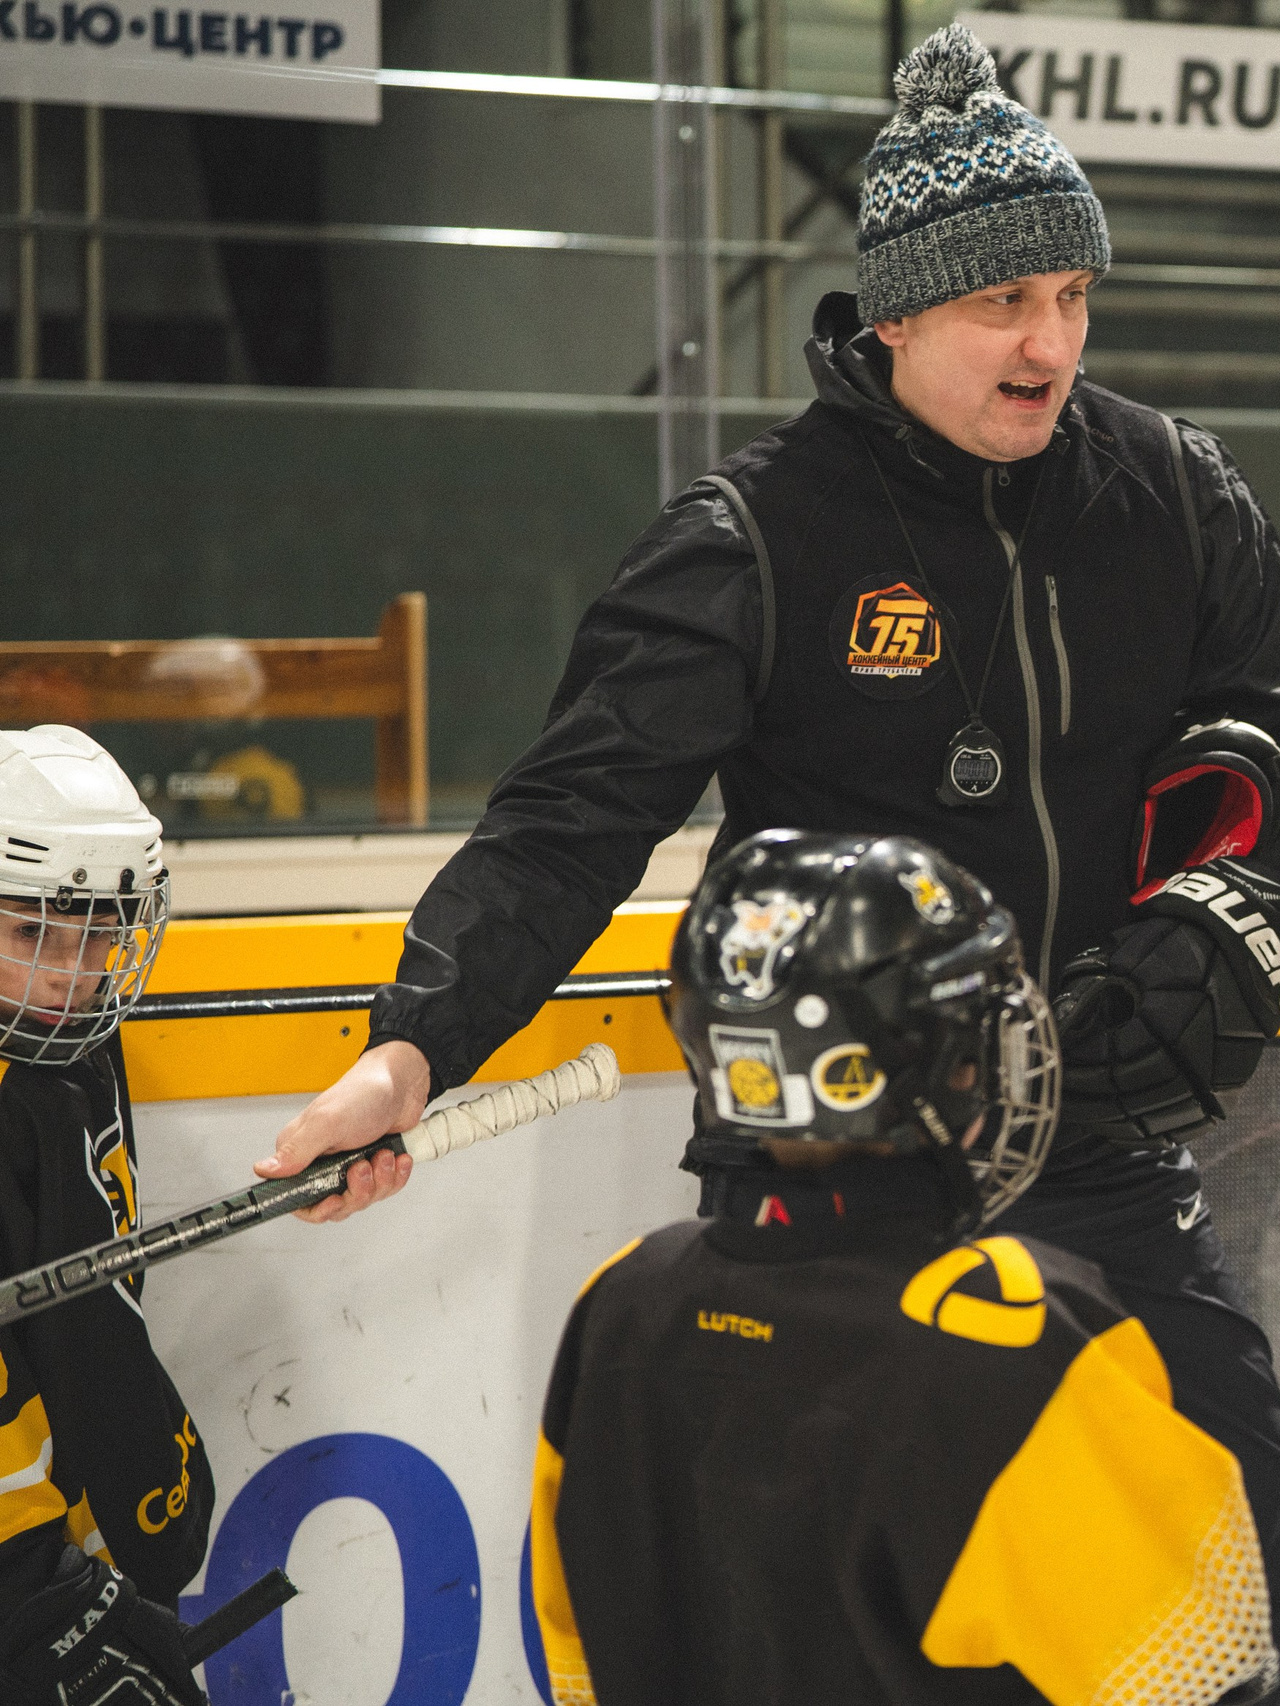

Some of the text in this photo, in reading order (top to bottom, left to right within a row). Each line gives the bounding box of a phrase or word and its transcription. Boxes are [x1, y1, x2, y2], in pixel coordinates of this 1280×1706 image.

[852, 654, 928, 666] ХОККЕЙНЫЙ ЦЕНТР
[698, 1310, 774, 1342] LUTCH
